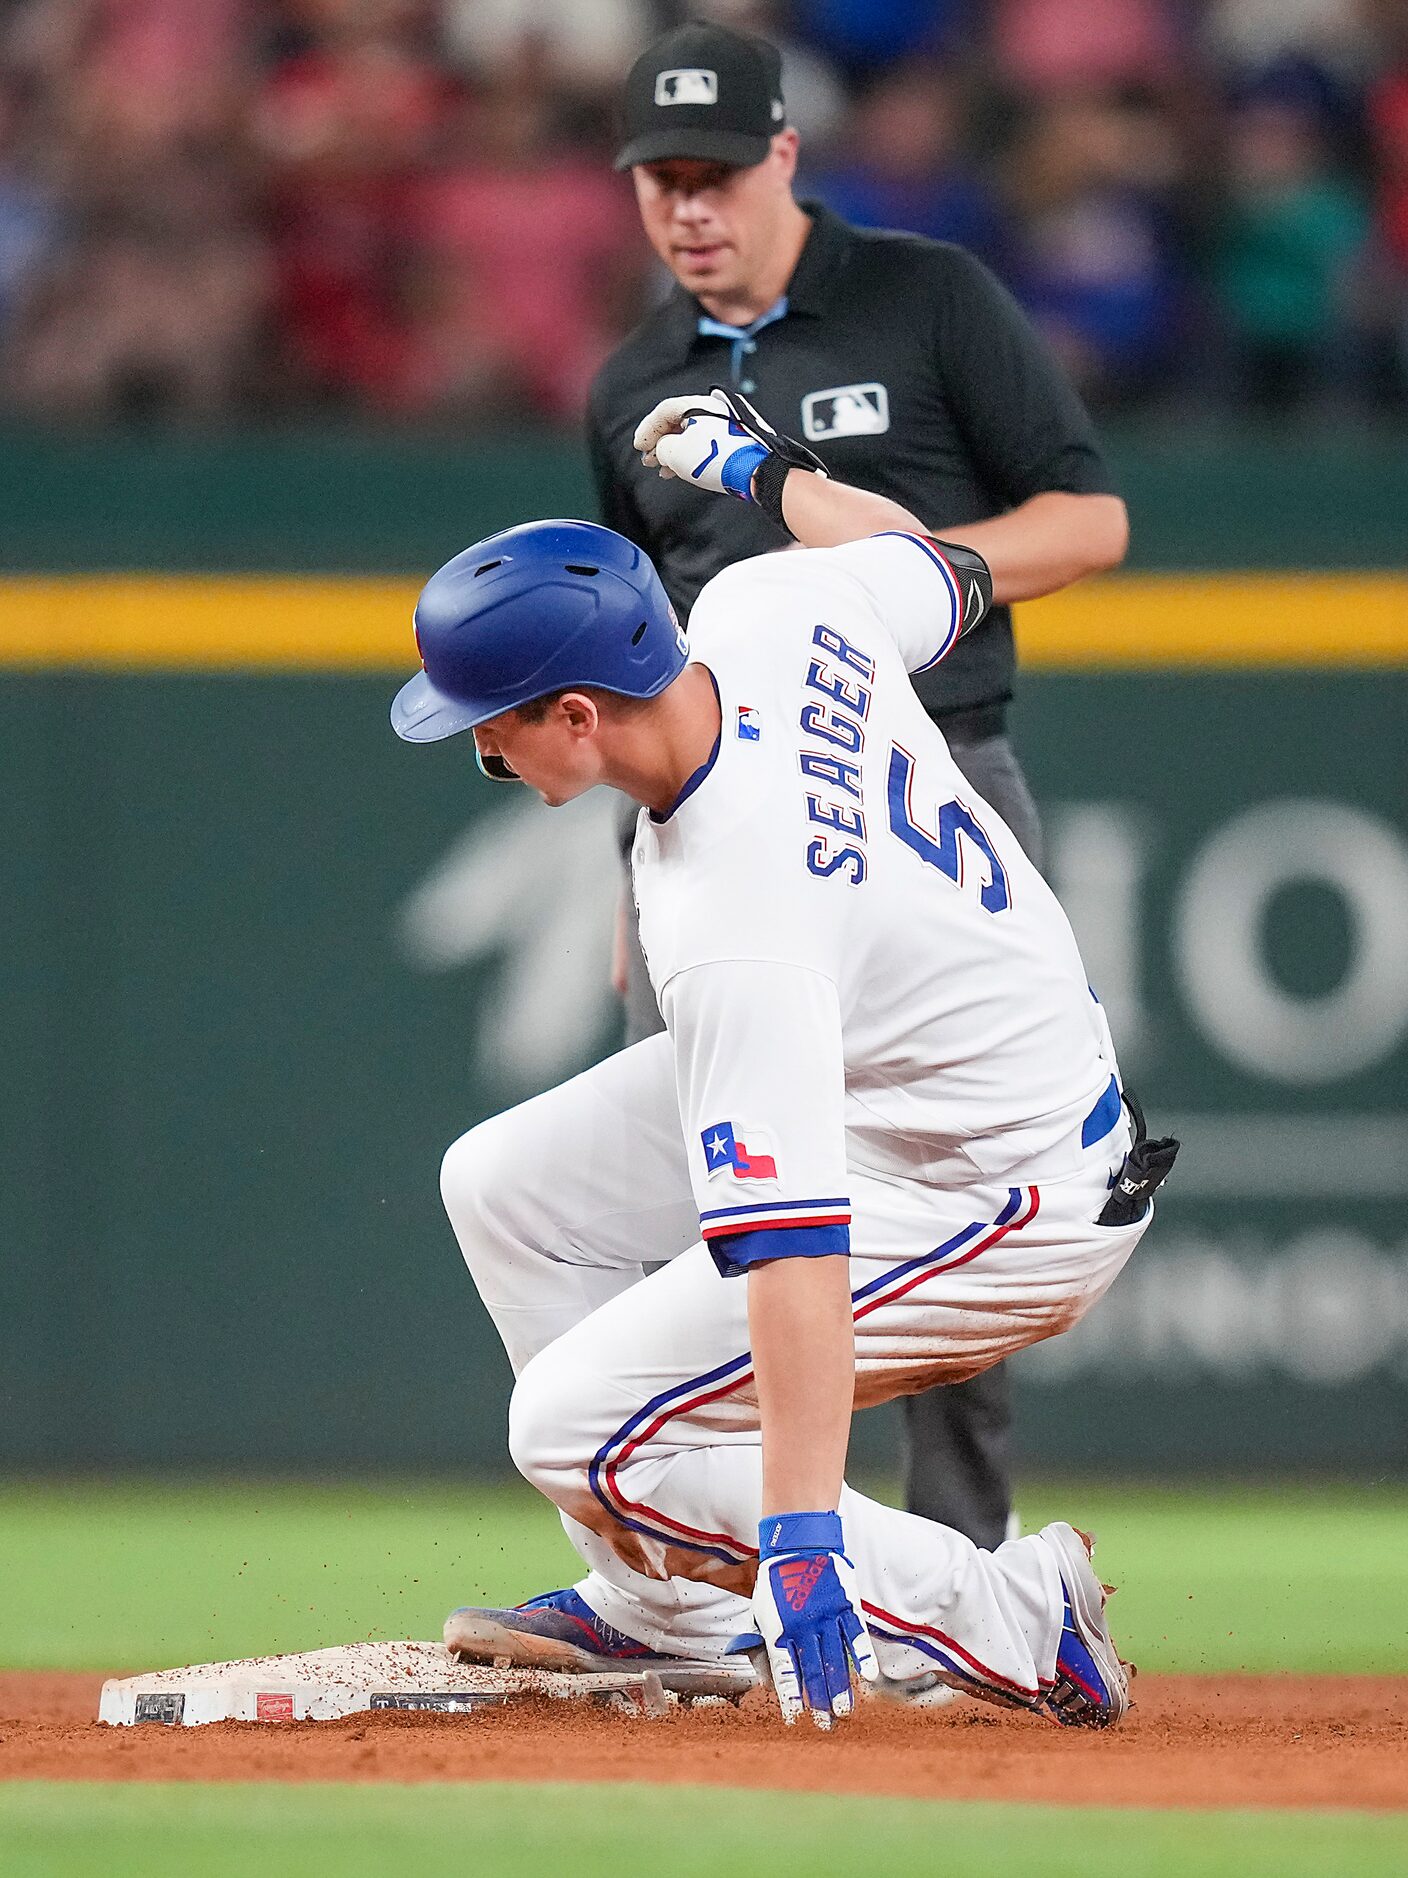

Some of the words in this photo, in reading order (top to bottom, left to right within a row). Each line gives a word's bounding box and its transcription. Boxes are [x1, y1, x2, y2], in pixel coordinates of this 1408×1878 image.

[800, 622, 876, 888] SEAGER
[885, 739, 1013, 916] 5
[791, 1554, 829, 1612] adidas
